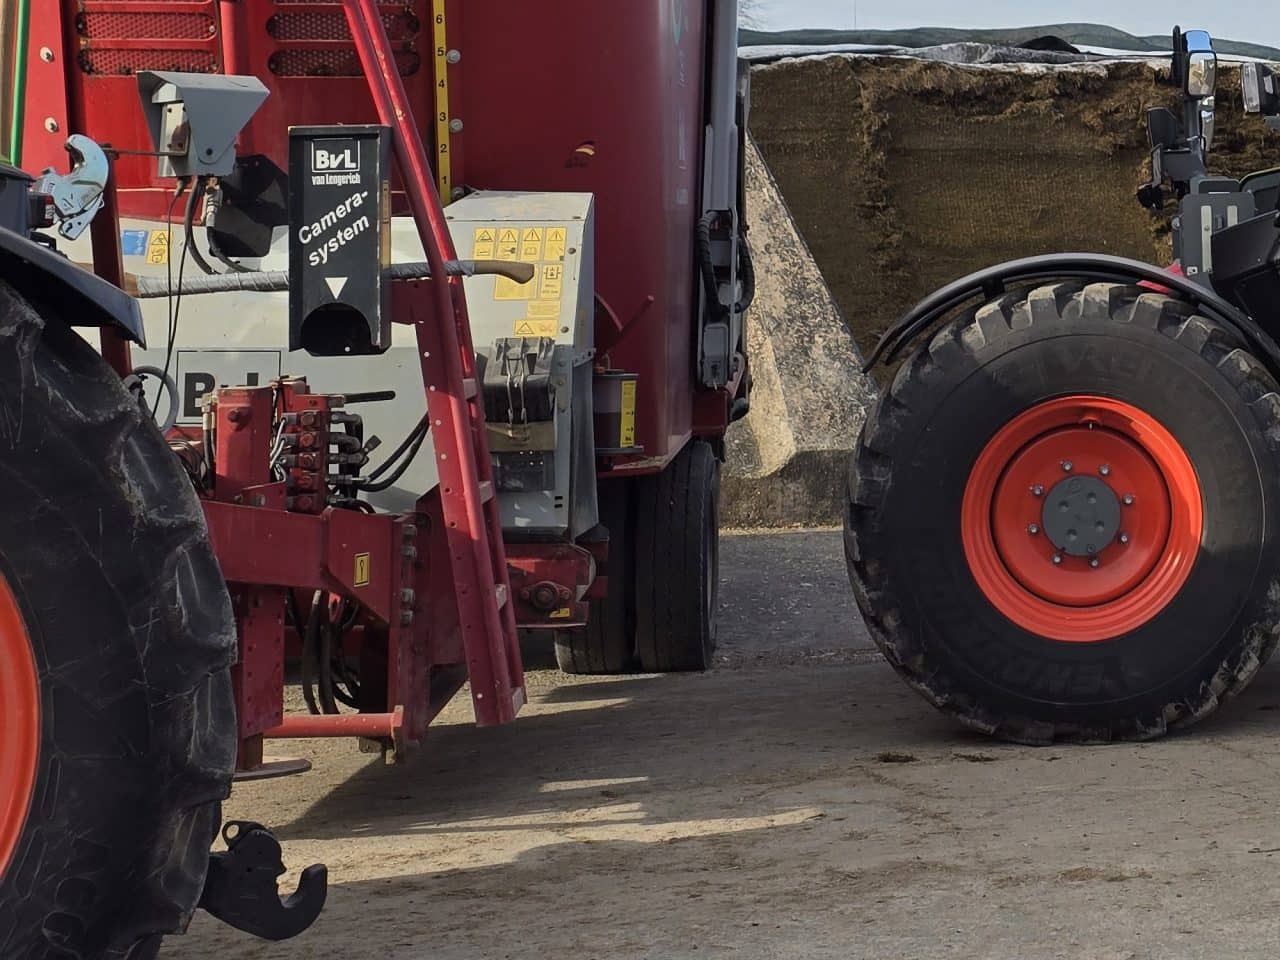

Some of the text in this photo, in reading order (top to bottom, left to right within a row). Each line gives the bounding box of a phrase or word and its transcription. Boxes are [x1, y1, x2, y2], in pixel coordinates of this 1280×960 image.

[435, 14, 443, 24] 6
[437, 47, 444, 56] 5
[438, 79, 445, 88] 4
[439, 112, 446, 121] 3
[440, 144, 447, 153] 2
[315, 149, 357, 169] BvL
[311, 172, 361, 186] van Lengerich
[441, 176, 447, 184] 1
[298, 190, 369, 244] Camera-
[308, 215, 370, 267] system
